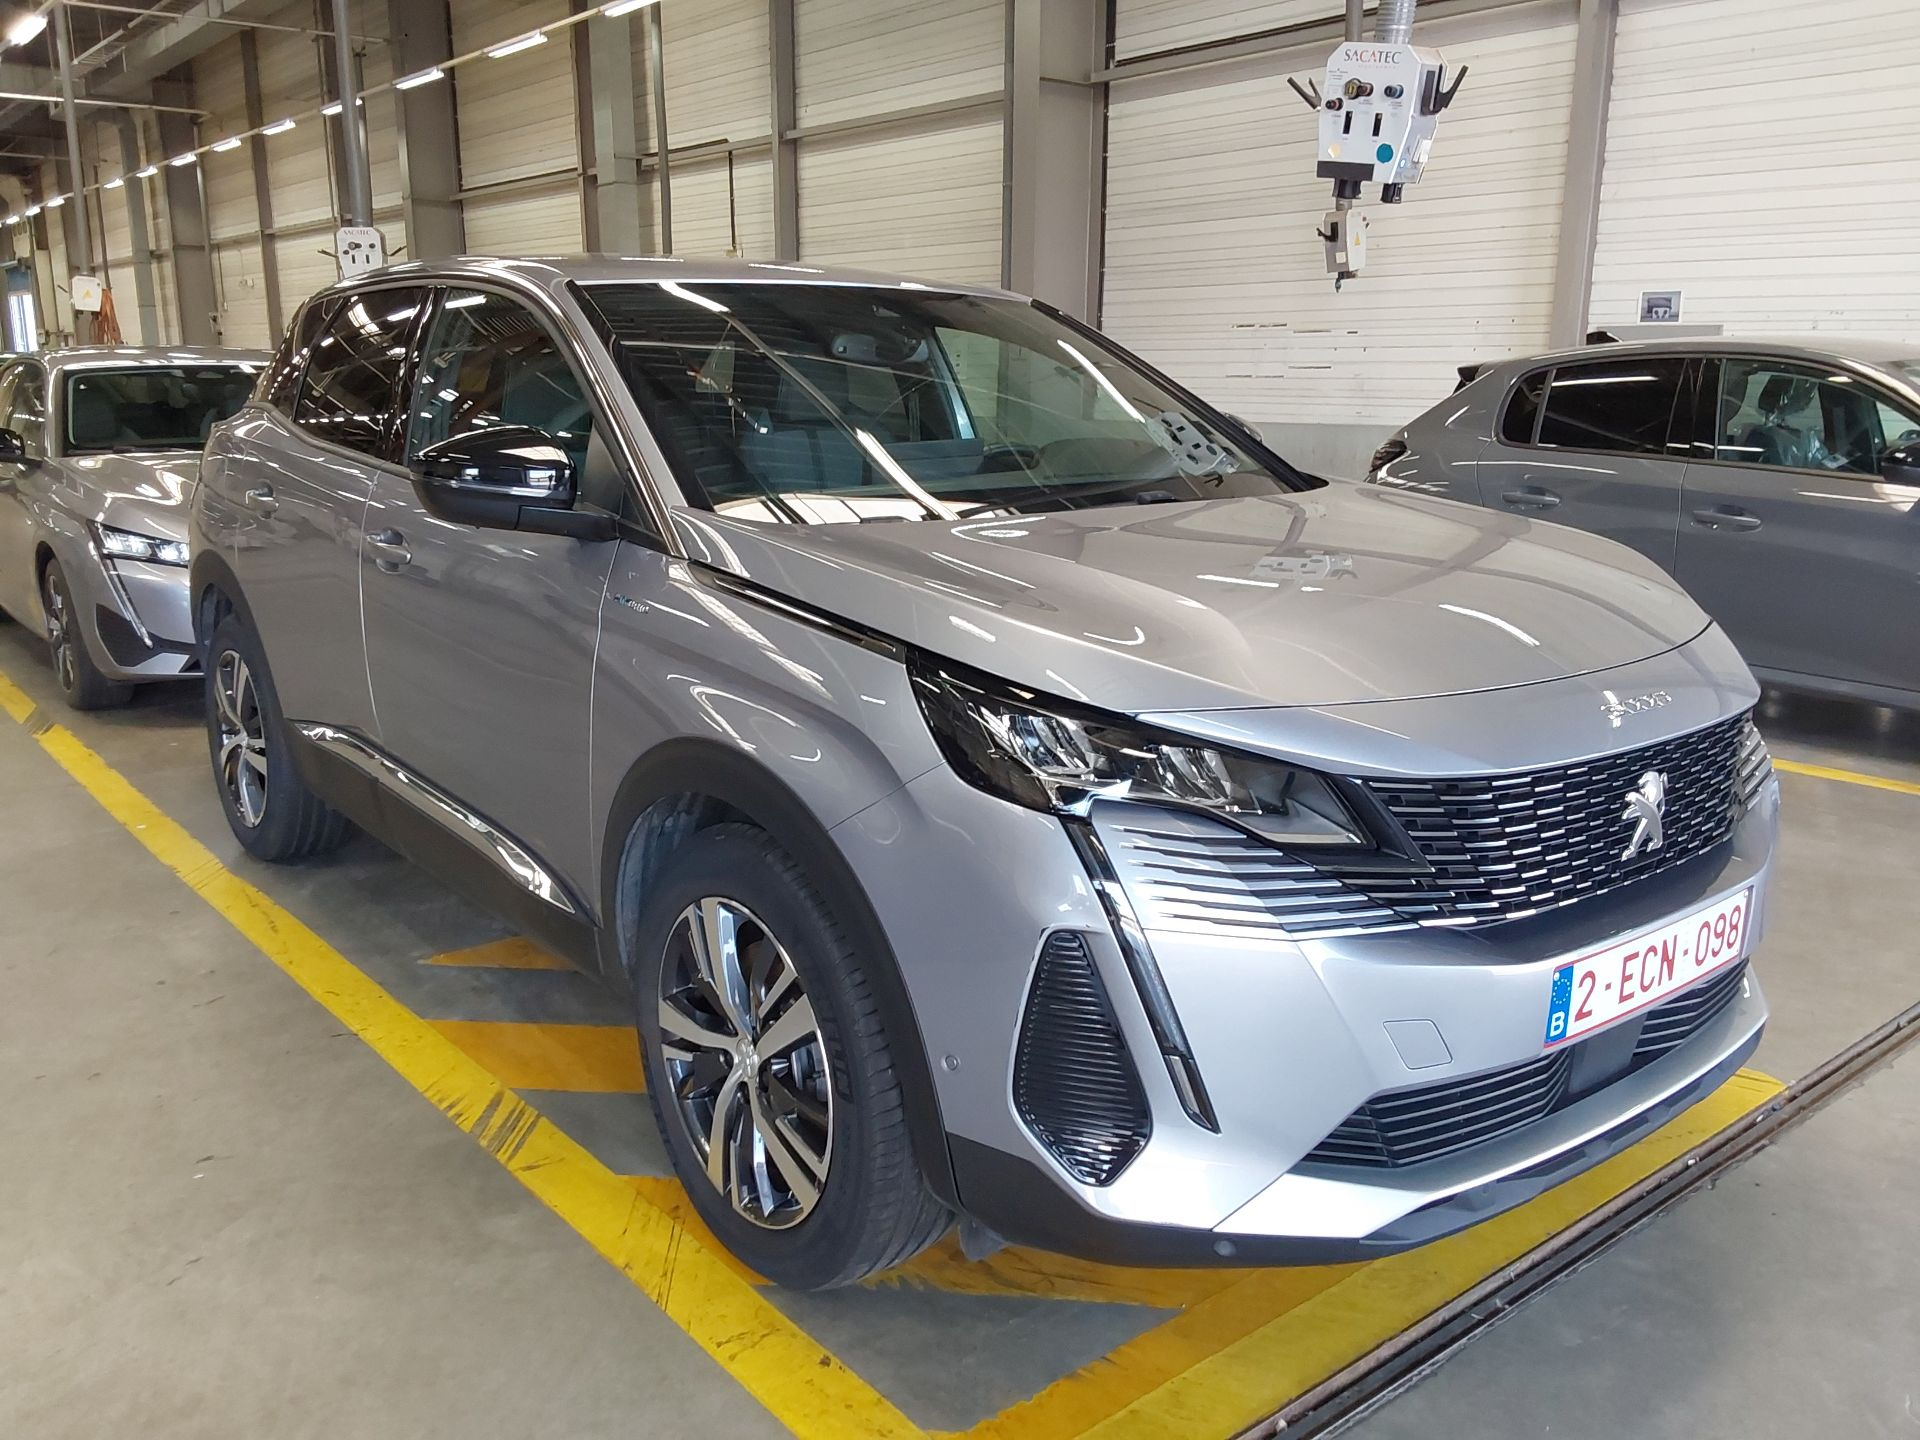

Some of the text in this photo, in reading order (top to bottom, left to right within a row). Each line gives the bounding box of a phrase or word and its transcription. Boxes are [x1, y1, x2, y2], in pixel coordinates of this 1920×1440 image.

[1344, 49, 1401, 64] SACATEC
[1574, 905, 1741, 1022] 2-ECN-098
[1550, 1011, 1565, 1036] B
